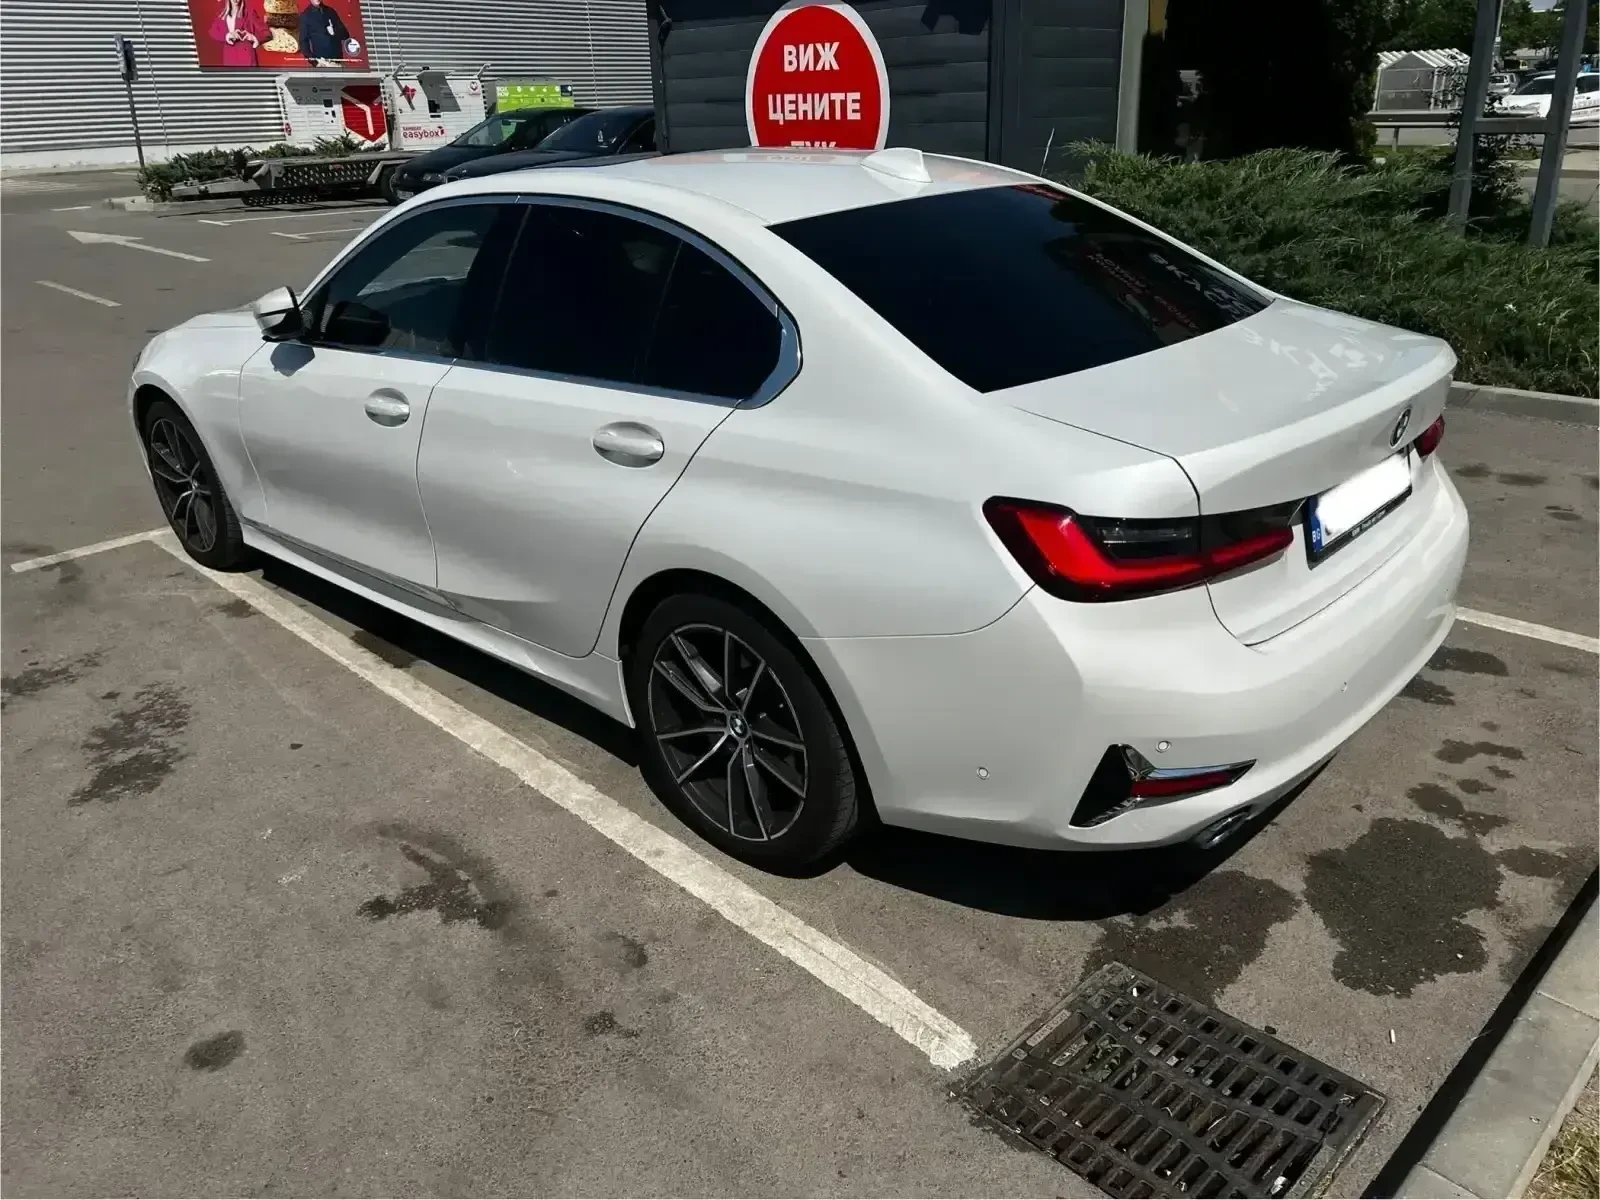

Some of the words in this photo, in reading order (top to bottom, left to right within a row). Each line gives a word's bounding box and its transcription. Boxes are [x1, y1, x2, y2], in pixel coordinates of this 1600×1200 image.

[783, 41, 841, 73] ВИЖ
[767, 92, 862, 126] ЦЕНИТЕ
[402, 129, 440, 140] easybox
[1312, 528, 1321, 543] BG
